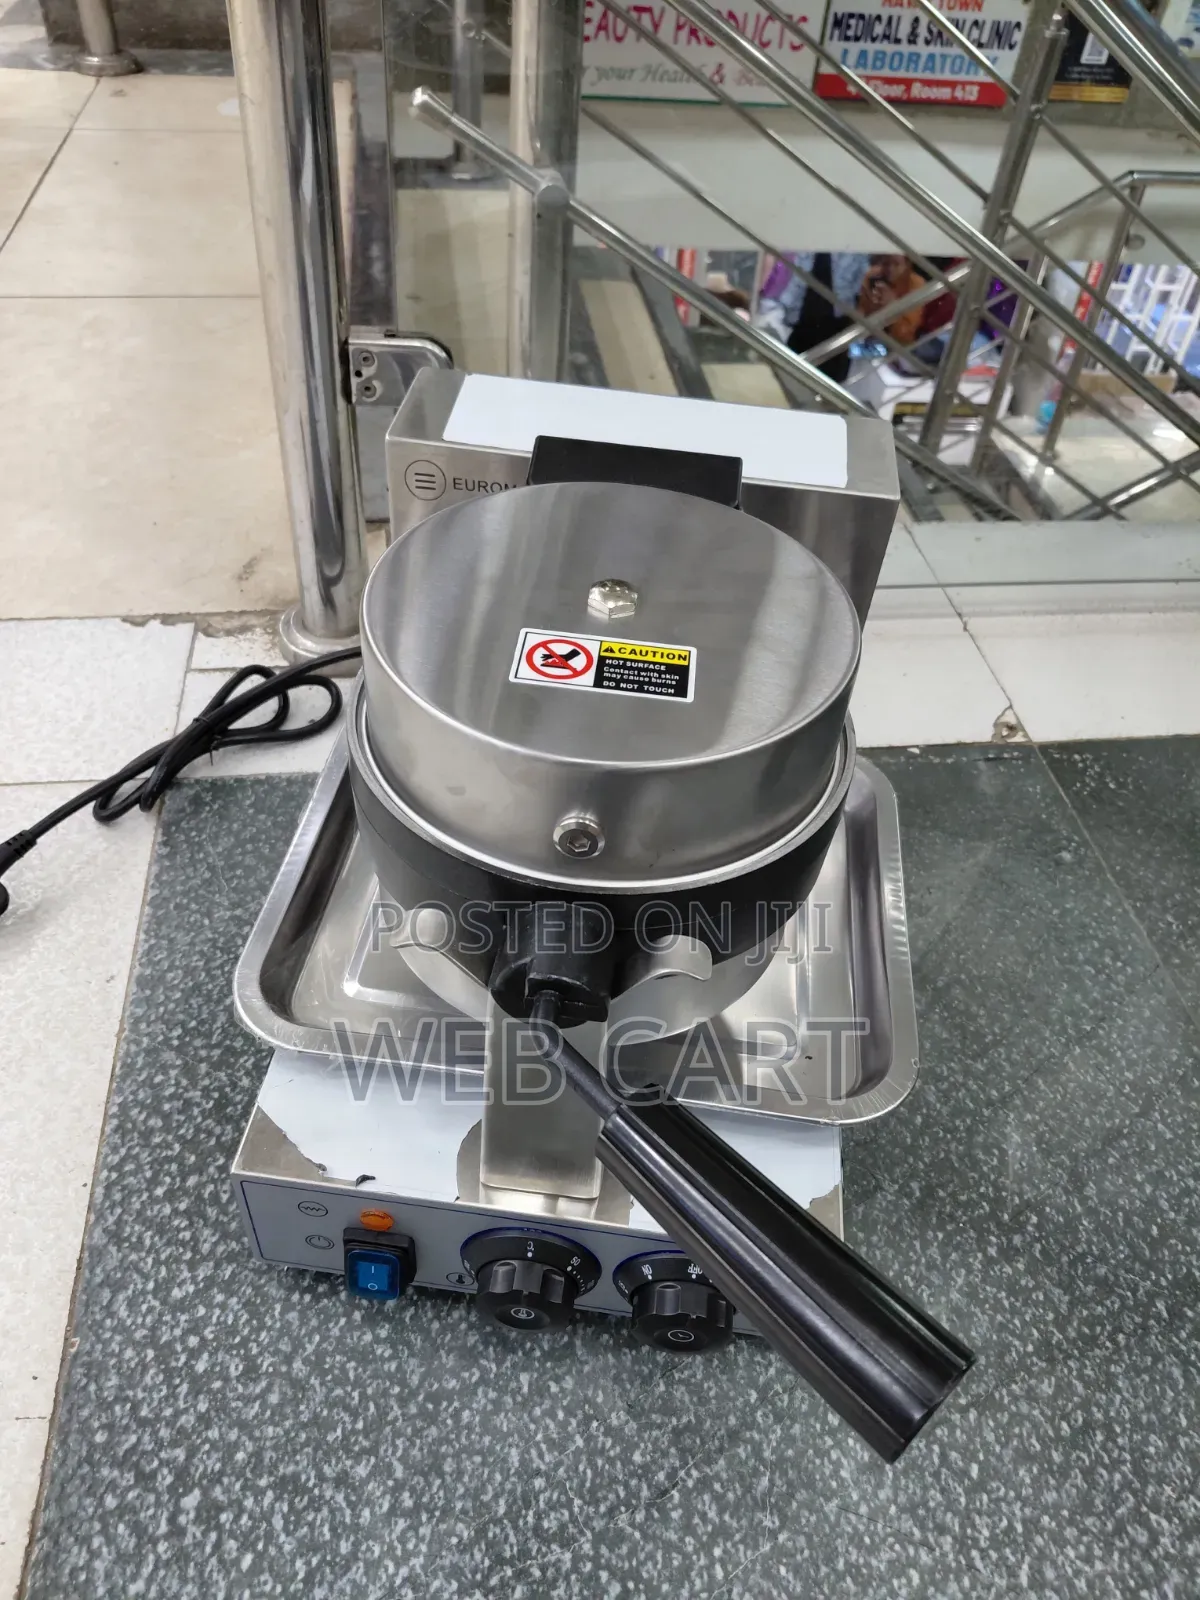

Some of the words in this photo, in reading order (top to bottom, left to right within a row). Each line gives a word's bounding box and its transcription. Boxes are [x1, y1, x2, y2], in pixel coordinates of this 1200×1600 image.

[584, 0, 665, 43] EAUTY
[829, 12, 902, 45] MEDICAL
[906, 16, 920, 45] &
[966, 19, 1022, 50] CLINIC
[618, 646, 688, 662] CAUTION
[605, 658, 625, 667] HOT
[626, 661, 666, 671] SURFACE
[603, 666, 638, 676] Contact
[661, 673, 680, 681] skin
[603, 672, 622, 680] may
[651, 677, 677, 685] burns
[602, 680, 616, 688] DO
[620, 682, 639, 690] NOT
[643, 685, 675, 694] TOUCH
[641, 1263, 653, 1276] ON
